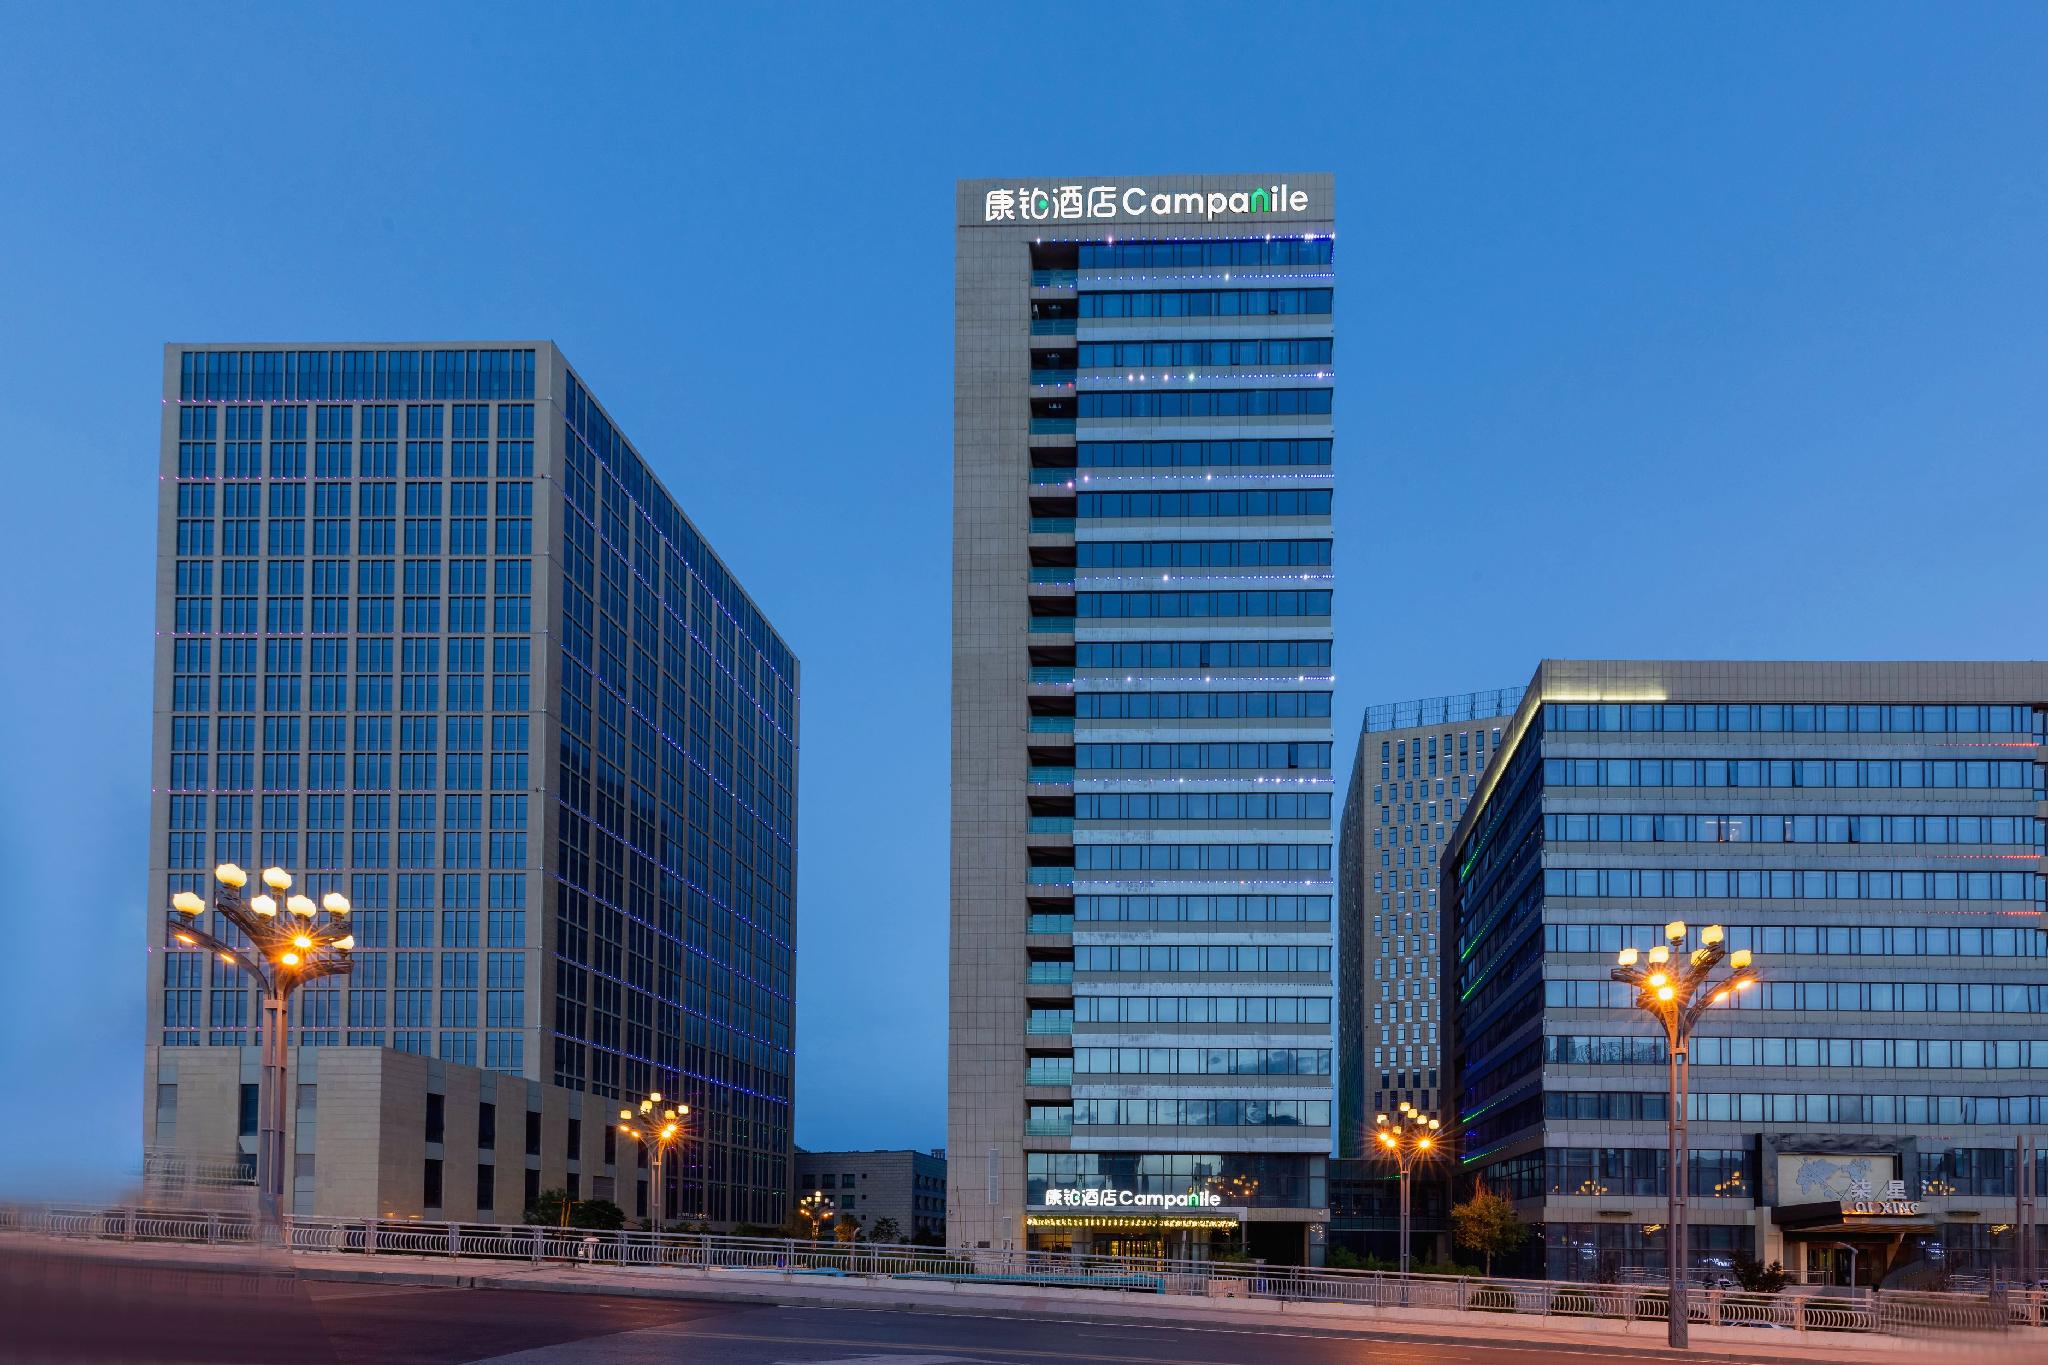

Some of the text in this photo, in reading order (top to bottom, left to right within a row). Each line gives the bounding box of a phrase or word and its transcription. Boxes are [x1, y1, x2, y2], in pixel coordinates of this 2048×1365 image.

[1122, 183, 1309, 221] Campanile
[1119, 1190, 1222, 1209] Campanile
[1880, 1201, 1920, 1214] XING
